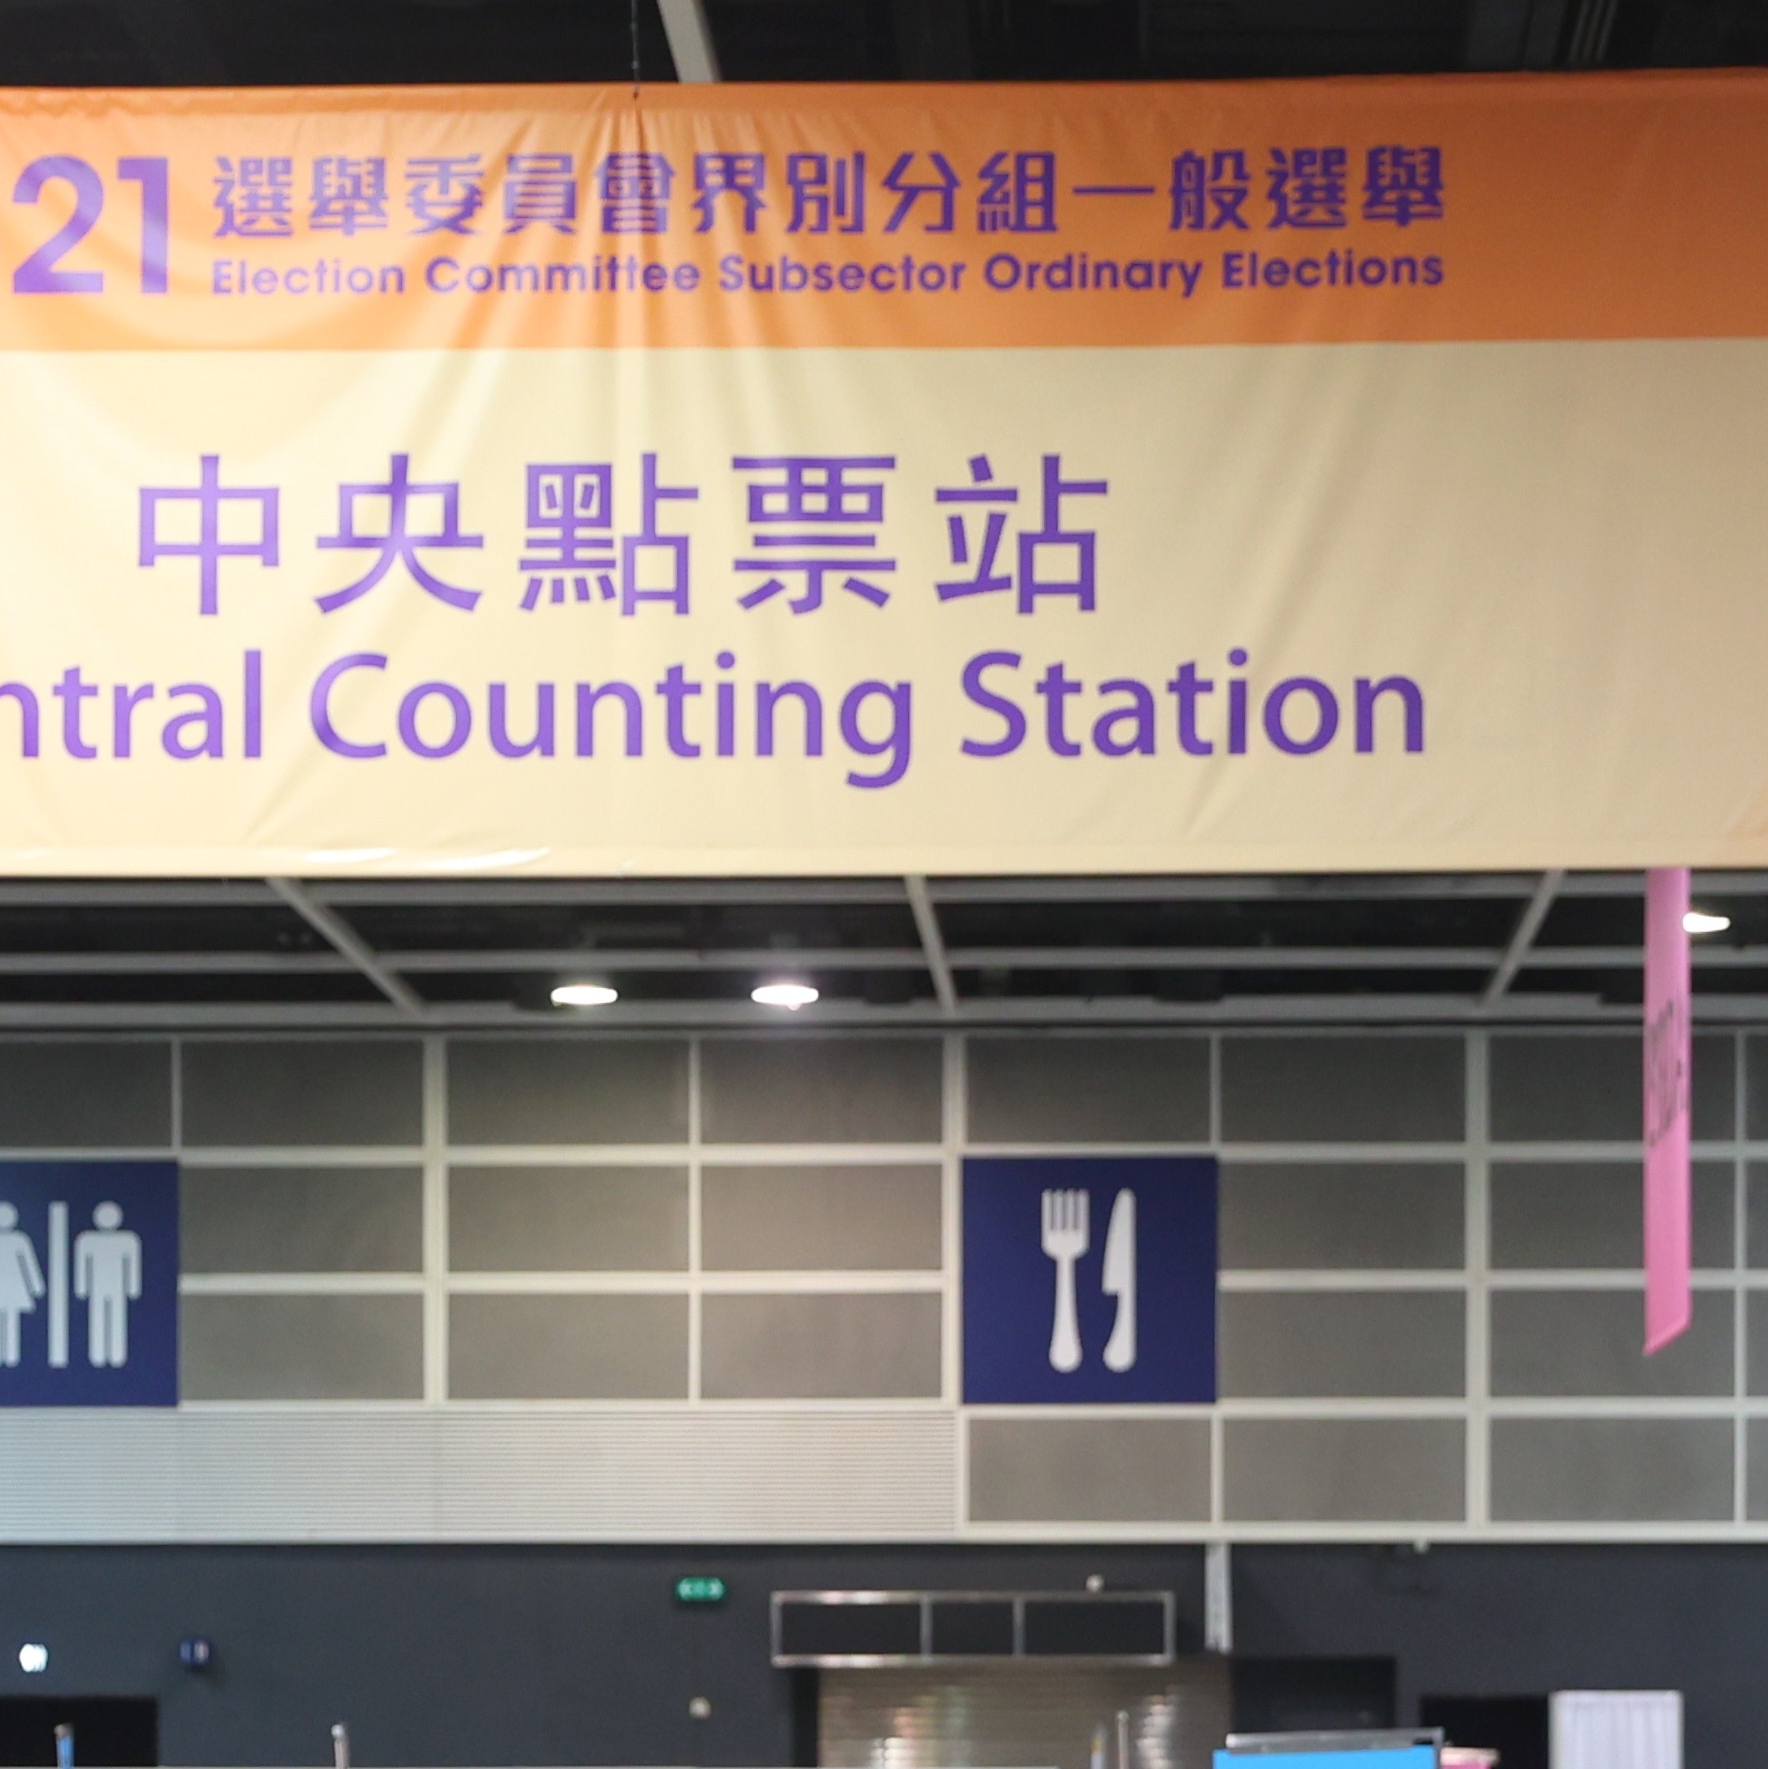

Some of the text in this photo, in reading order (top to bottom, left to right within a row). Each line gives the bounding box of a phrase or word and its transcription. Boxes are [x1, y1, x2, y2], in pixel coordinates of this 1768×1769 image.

[212, 145, 1444, 239] 選舉委員會界別分組一般選舉
[213, 247, 1444, 299] Election Committee Subsector Ordinary Elections
[137, 452, 1109, 617] 中央點票站
[308, 650, 913, 790] Counting
[960, 648, 1425, 758] Station
